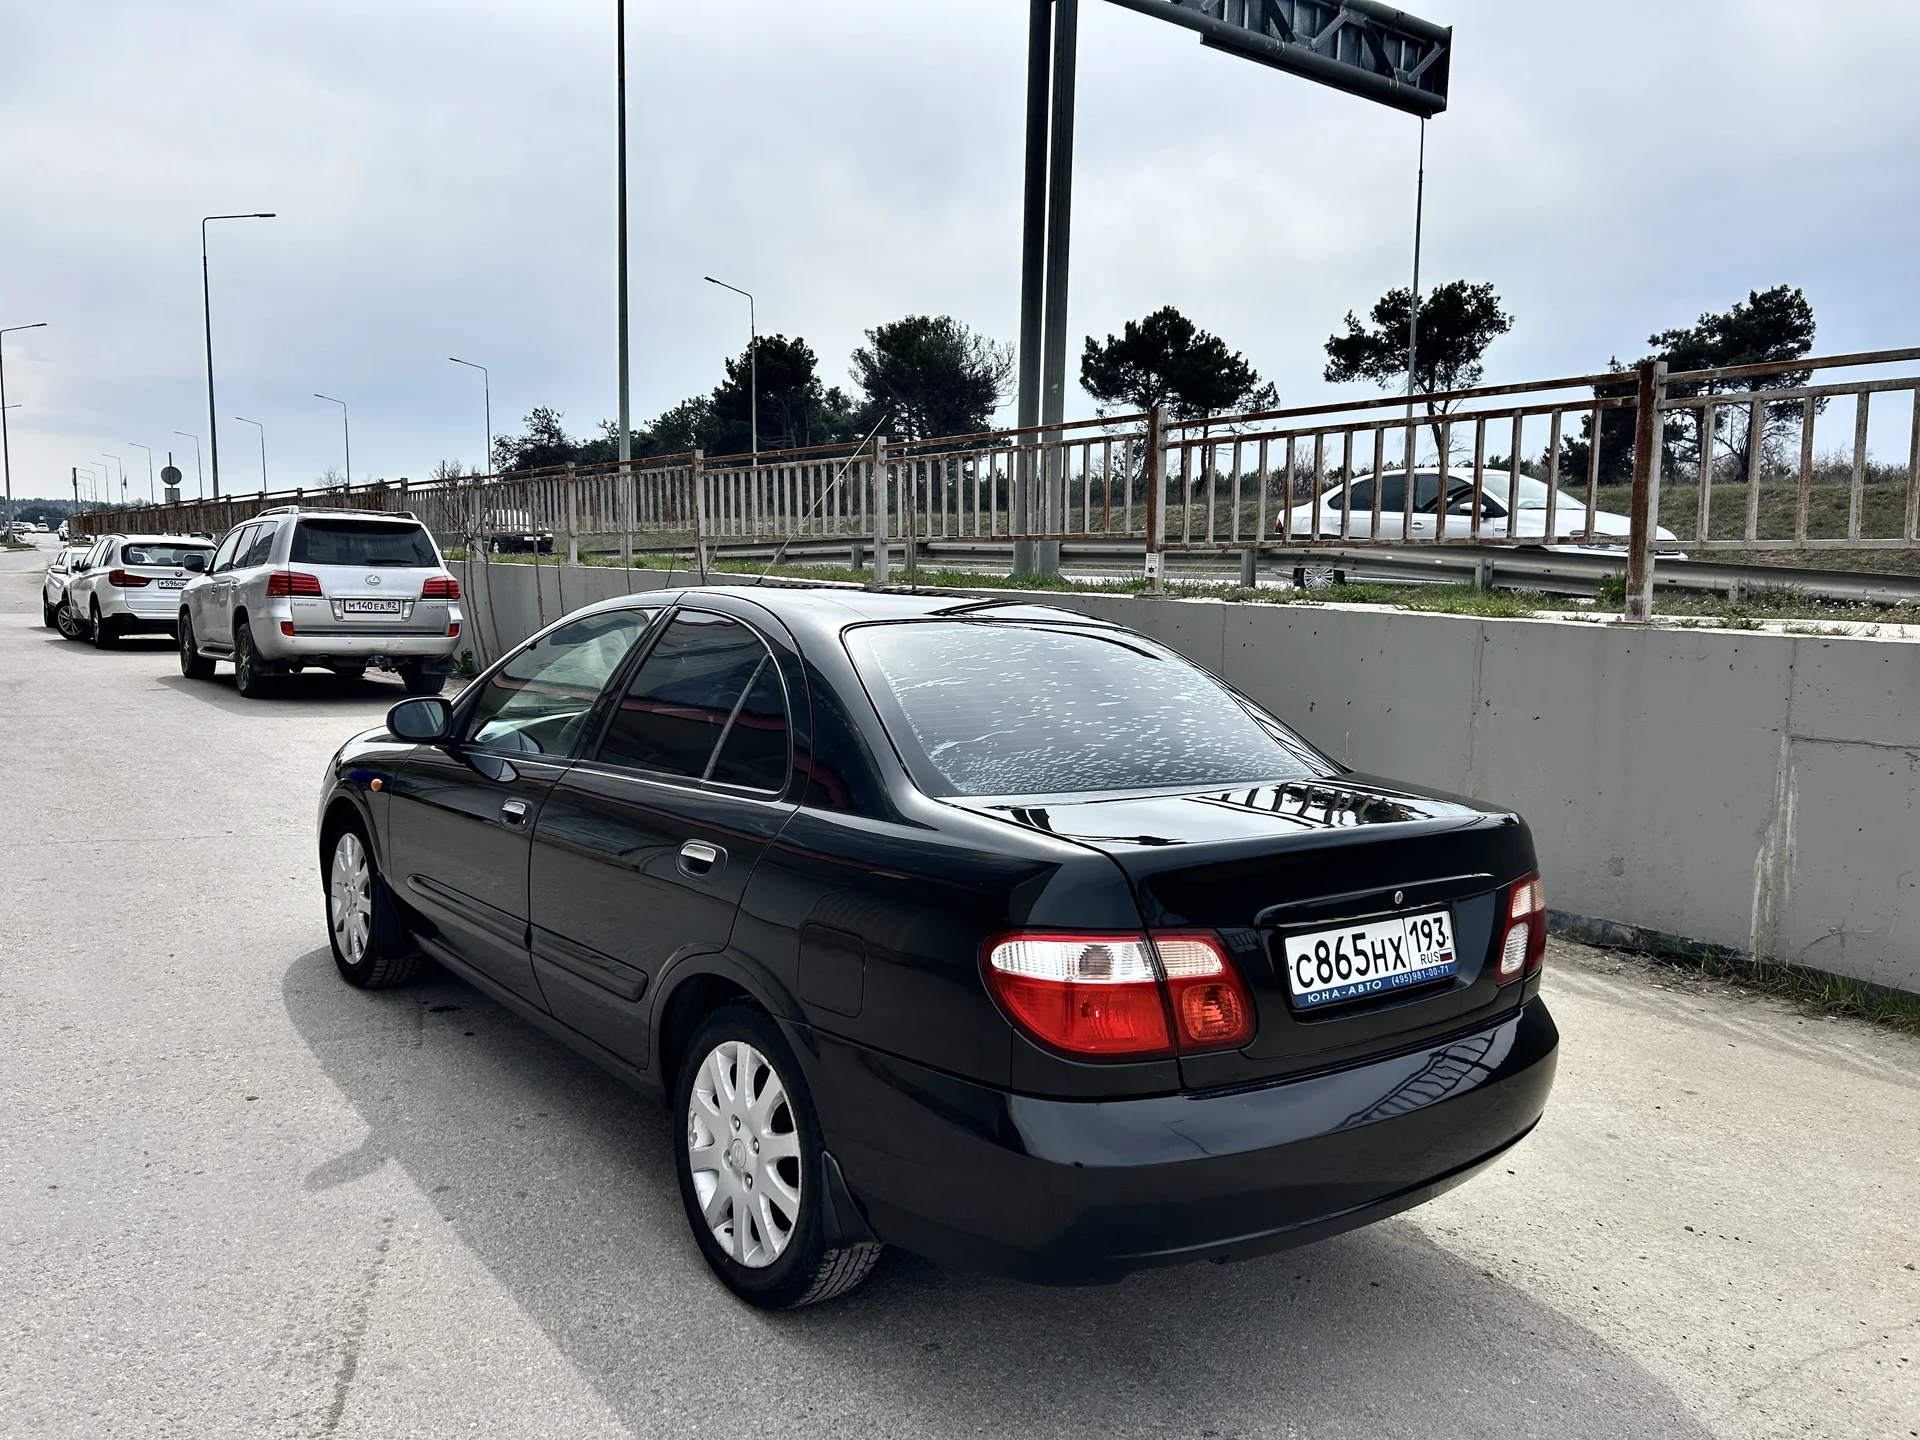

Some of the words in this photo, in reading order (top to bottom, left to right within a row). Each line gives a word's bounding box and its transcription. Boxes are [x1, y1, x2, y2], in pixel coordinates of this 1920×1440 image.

[348, 601, 385, 610] М140ЕА
[1296, 931, 1407, 989] С865НХ
[1409, 917, 1446, 953] 193
[1420, 951, 1440, 966] RUS
